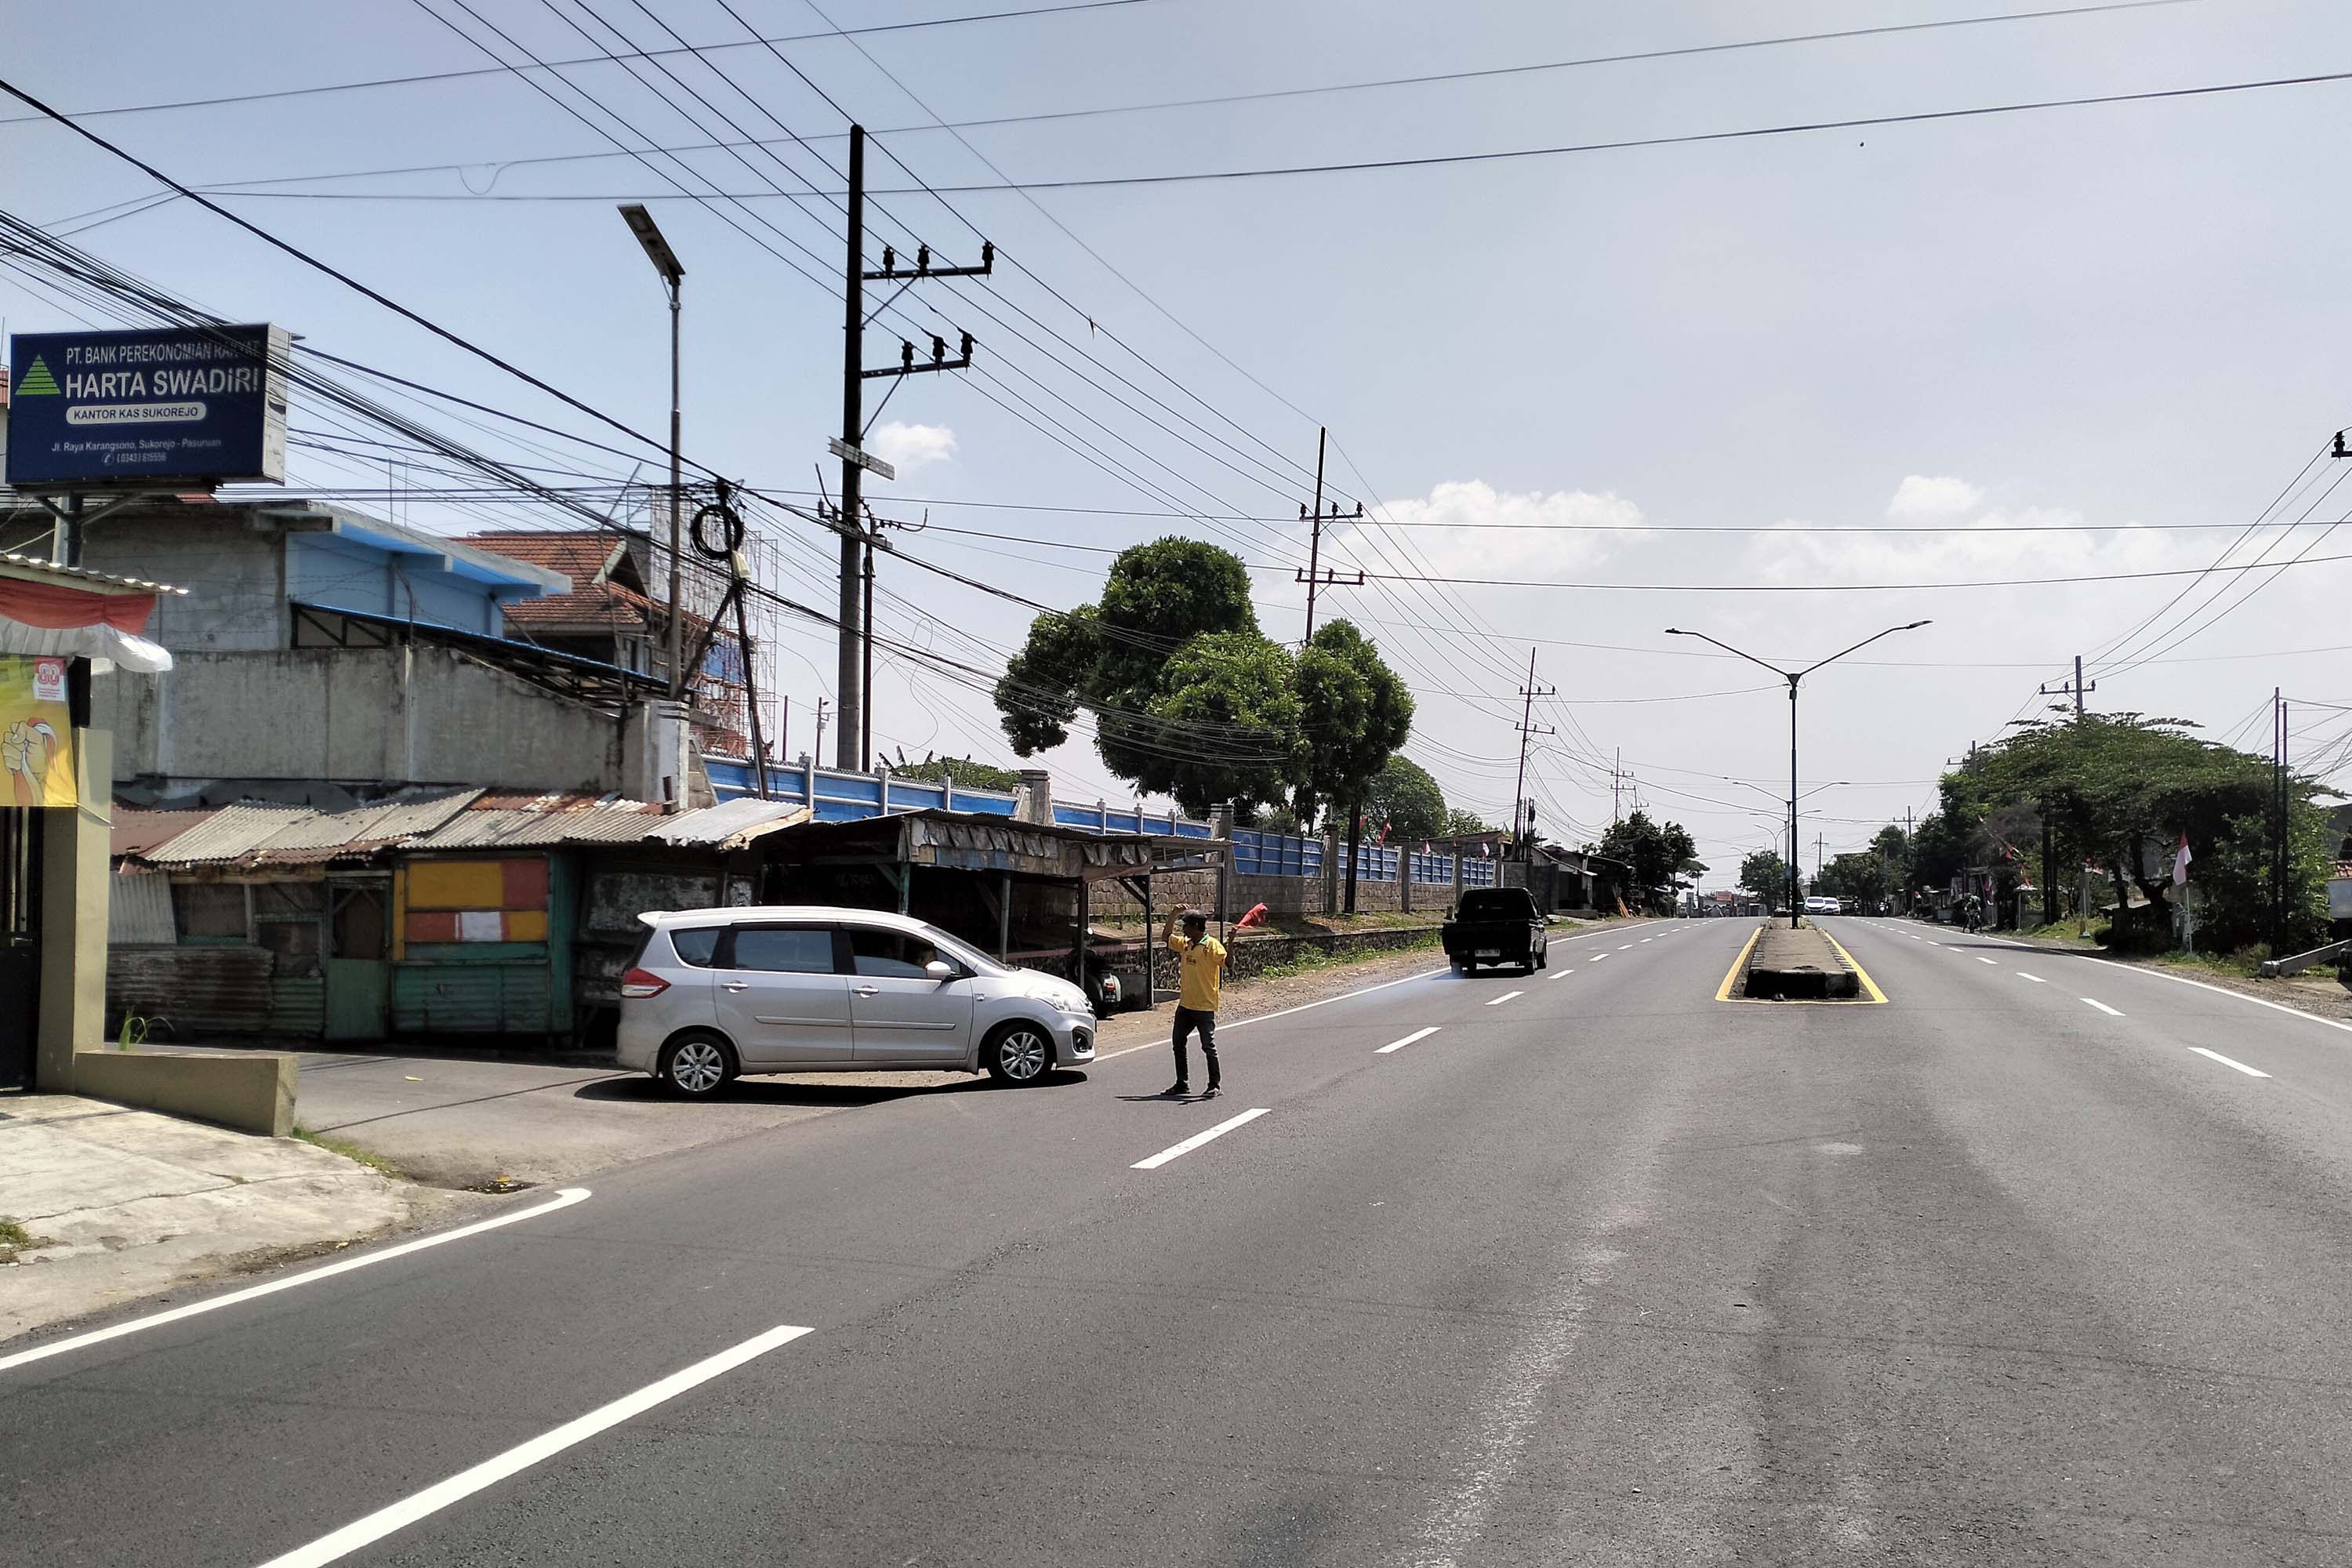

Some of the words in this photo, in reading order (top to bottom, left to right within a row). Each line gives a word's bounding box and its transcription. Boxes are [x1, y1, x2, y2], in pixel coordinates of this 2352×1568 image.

[67, 347, 82, 365] PT.
[85, 347, 116, 365] BANK
[119, 343, 212, 363] PEREKONOMIAN
[66, 371, 147, 399] HARTA
[74, 408, 117, 421] KANTOR
[118, 407, 140, 419] KAS
[142, 405, 199, 418] SUKOREJO
[52, 443, 61, 452] Jl.
[64, 442, 84, 453] Raya
[85, 440, 137, 452] Karangsono,
[139, 439, 176, 451] Sukorejo
[182, 438, 222, 447] Pasuruan
